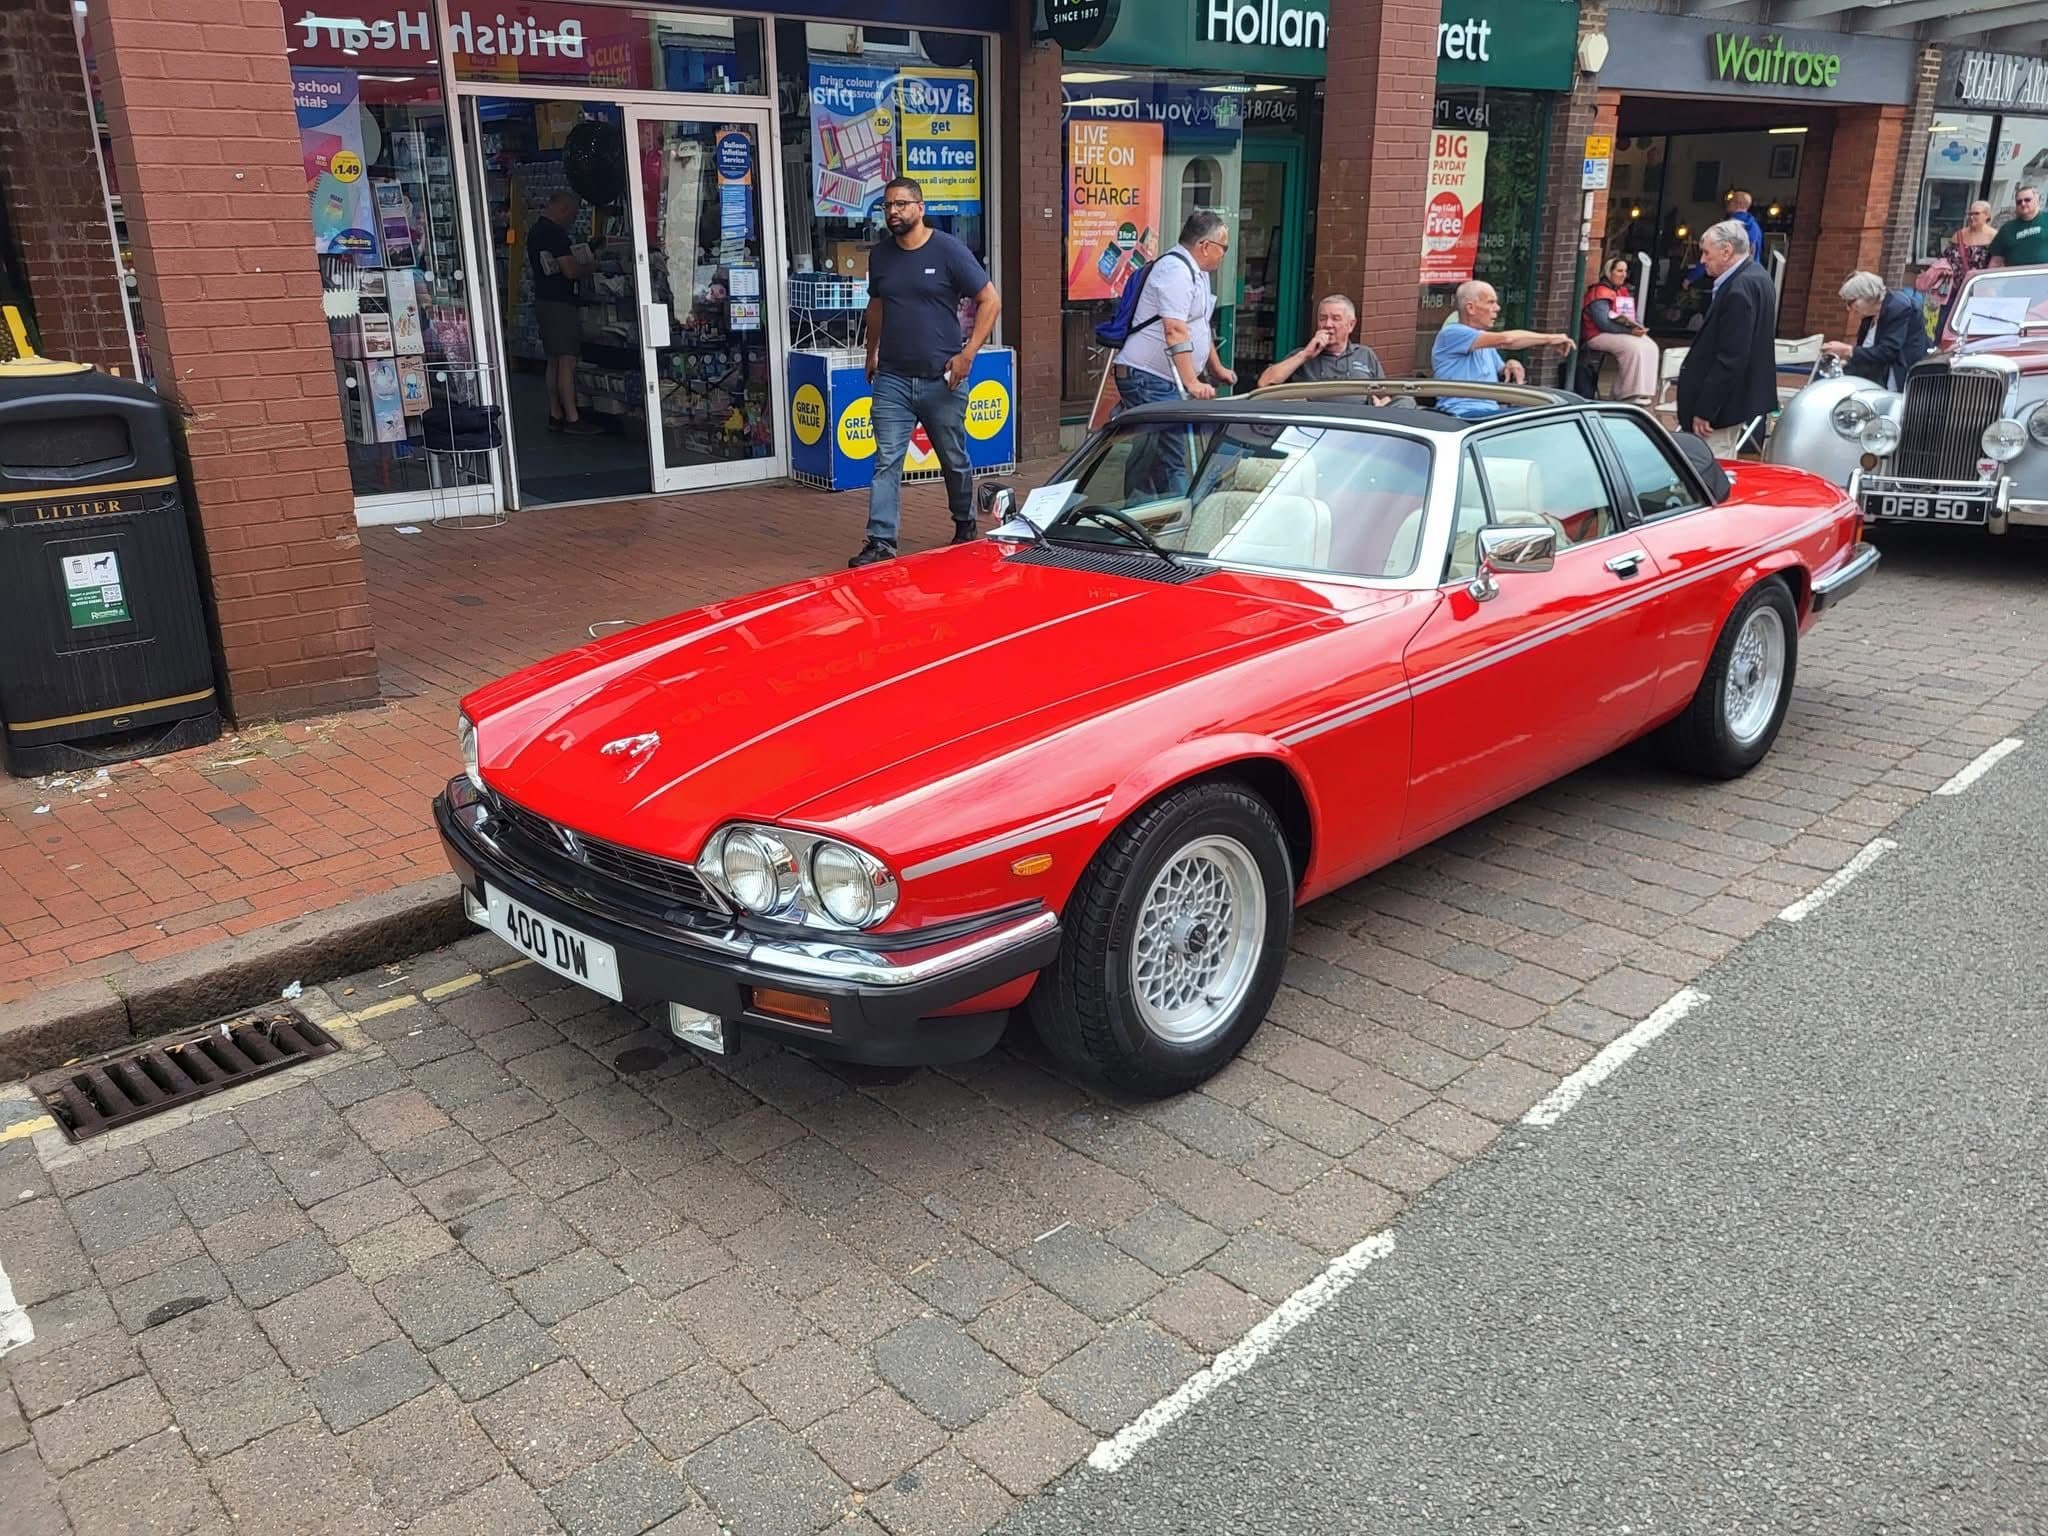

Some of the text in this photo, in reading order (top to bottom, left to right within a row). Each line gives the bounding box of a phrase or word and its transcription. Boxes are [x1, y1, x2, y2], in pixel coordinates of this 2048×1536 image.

[1054, 8, 1099, 24] SINCE 1870
[1208, 0, 1329, 49] Hollan
[1437, 18, 1491, 61] rett
[1715, 32, 1840, 87] Waitrose
[298, 80, 342, 95] school
[820, 75, 844, 89] Bring
[846, 77, 874, 88] colour
[1961, 59, 2019, 102] EGHAM
[293, 95, 328, 109] ntials
[909, 82, 952, 113] Buy
[931, 119, 951, 135] get
[1074, 125, 1109, 145] LIVE
[1435, 134, 1468, 158] BIG
[908, 146, 974, 165] 4th free
[1074, 145, 1135, 166] LIFE ON
[1433, 160, 1466, 172] PAYDAY
[1074, 167, 1112, 185] FULL
[1432, 173, 1465, 186] EVENT
[1074, 187, 1141, 206] CHARGE
[1427, 212, 1462, 234] Free
[796, 401, 820, 416] GREAT
[970, 397, 1002, 410] GREAT
[797, 413, 821, 428] VALUE
[845, 416, 874, 428] GREA
[971, 410, 1003, 422] VALUE
[846, 428, 873, 441] VALU
[36, 500, 121, 520] LITTER
[1881, 496, 1969, 520] DFB 50
[507, 903, 588, 980] 400 DW
